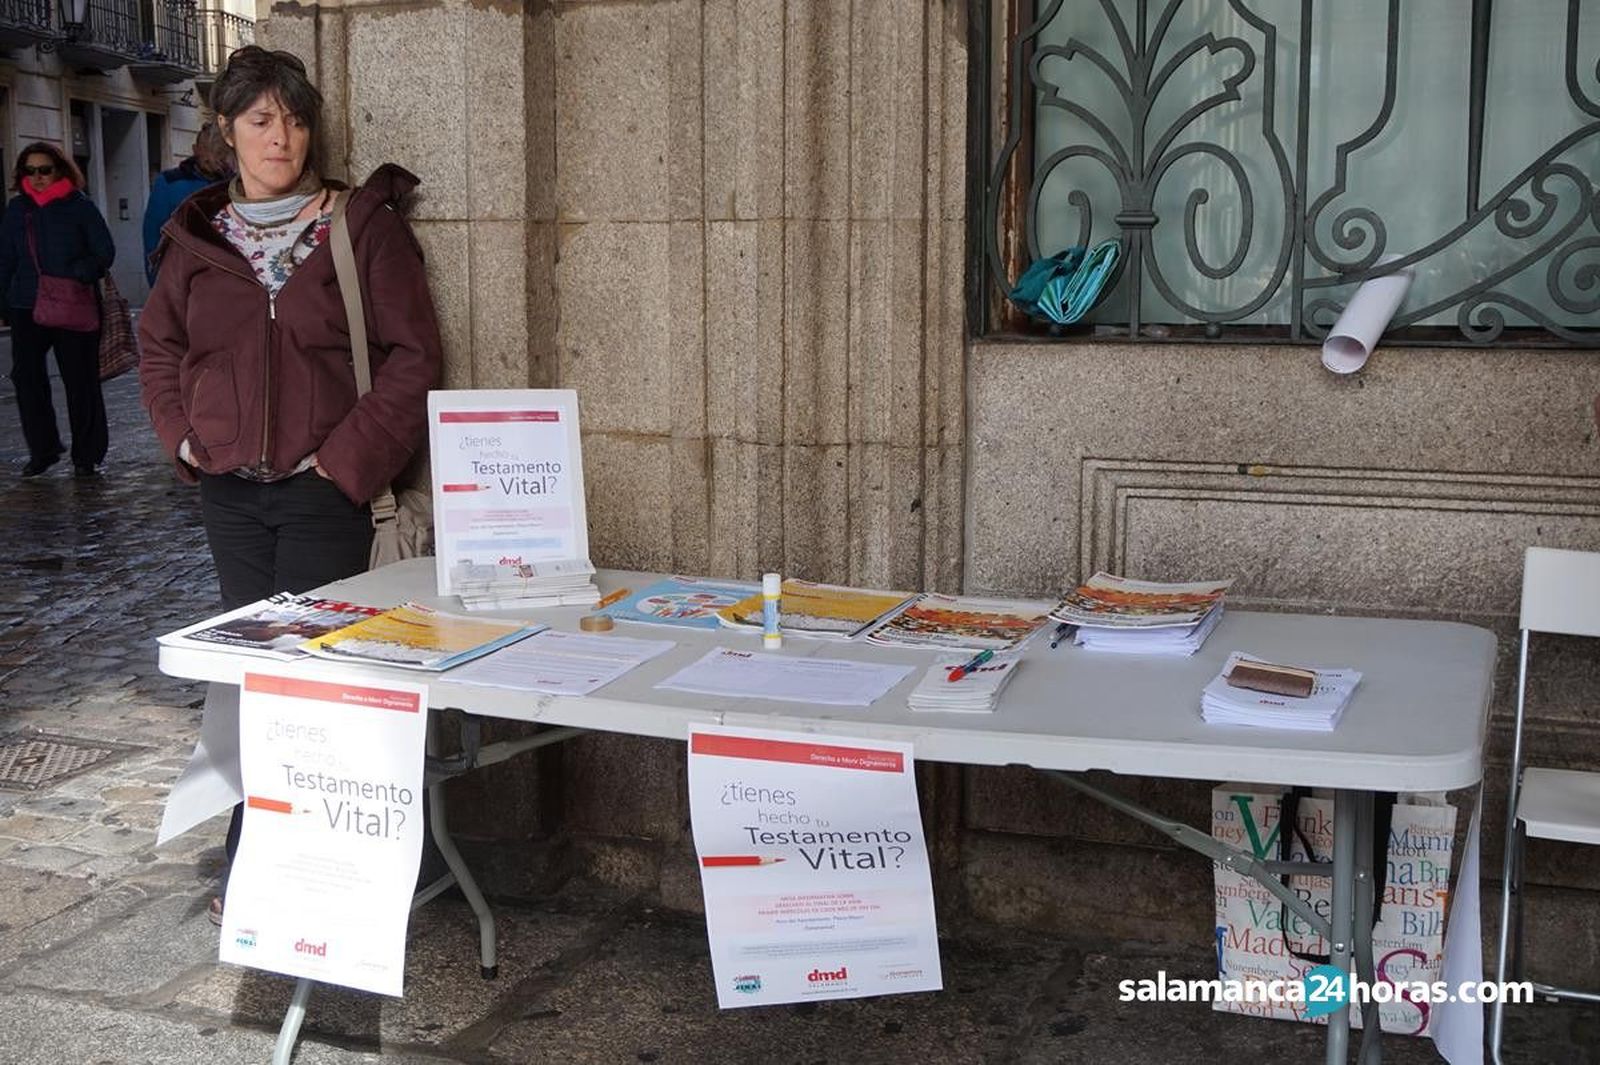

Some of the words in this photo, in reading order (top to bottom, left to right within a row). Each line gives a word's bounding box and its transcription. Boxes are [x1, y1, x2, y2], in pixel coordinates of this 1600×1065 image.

[471, 460, 562, 475] Testamento
[499, 476, 558, 495] Vital?
[266, 718, 328, 744] ¿tienes
[282, 764, 413, 805] Testamento
[721, 781, 796, 805] ¿tienes
[322, 797, 406, 840] Vital?
[758, 809, 810, 825] hecho
[816, 819, 830, 828] tu
[743, 826, 911, 845] Testamento
[799, 846, 905, 870] Vital?
[294, 938, 327, 957] dmd
[1226, 922, 1325, 957] Madrid
[807, 966, 848, 982] dmd
